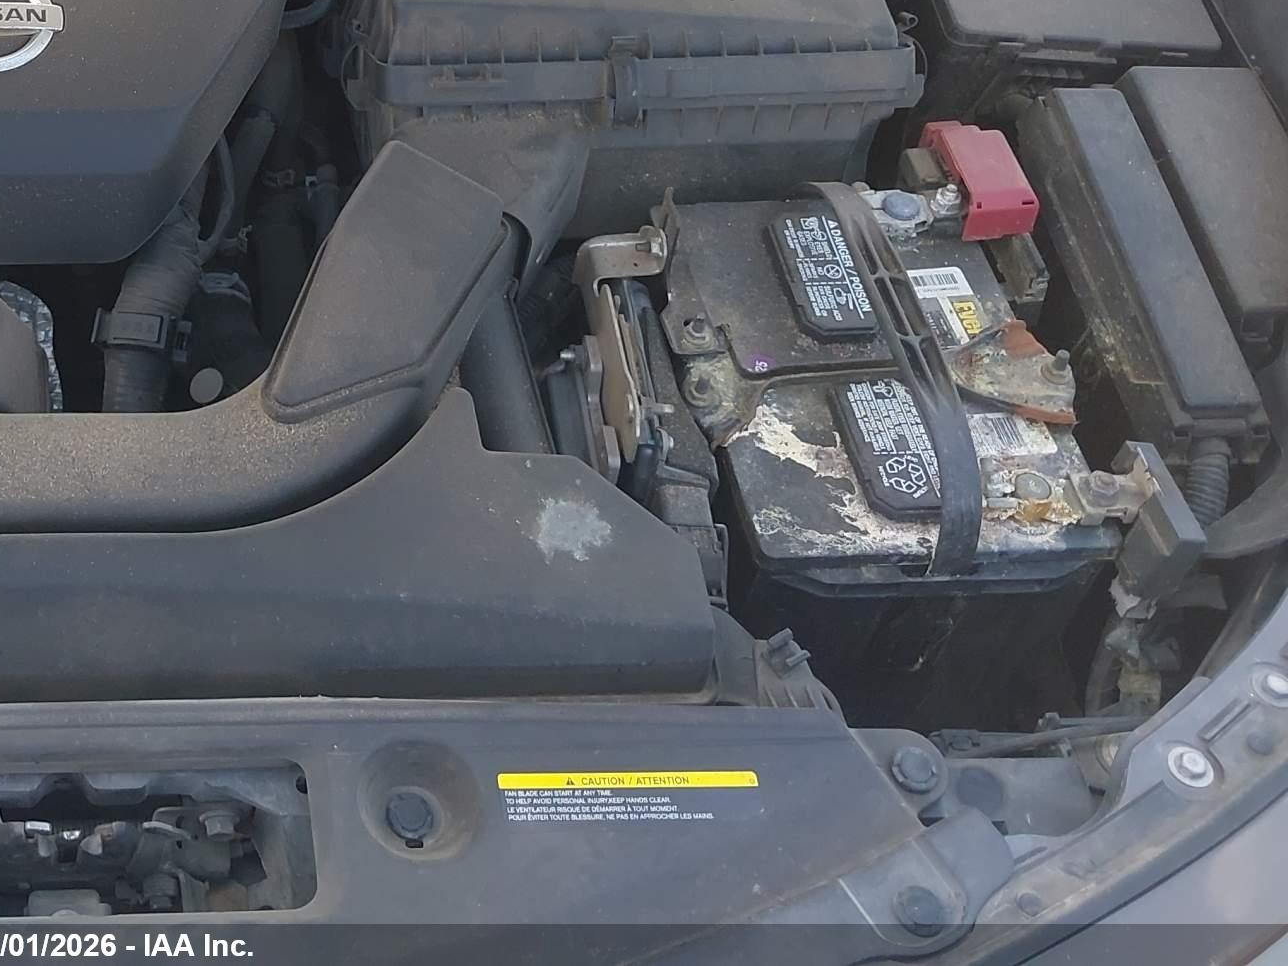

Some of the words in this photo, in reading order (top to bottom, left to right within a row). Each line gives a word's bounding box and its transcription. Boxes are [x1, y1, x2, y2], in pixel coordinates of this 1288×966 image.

[831, 229, 854, 268] DANGER
[849, 276, 872, 312] POISON
[581, 777, 625, 786] CAUTION
[636, 776, 690, 785] ATTENTION
